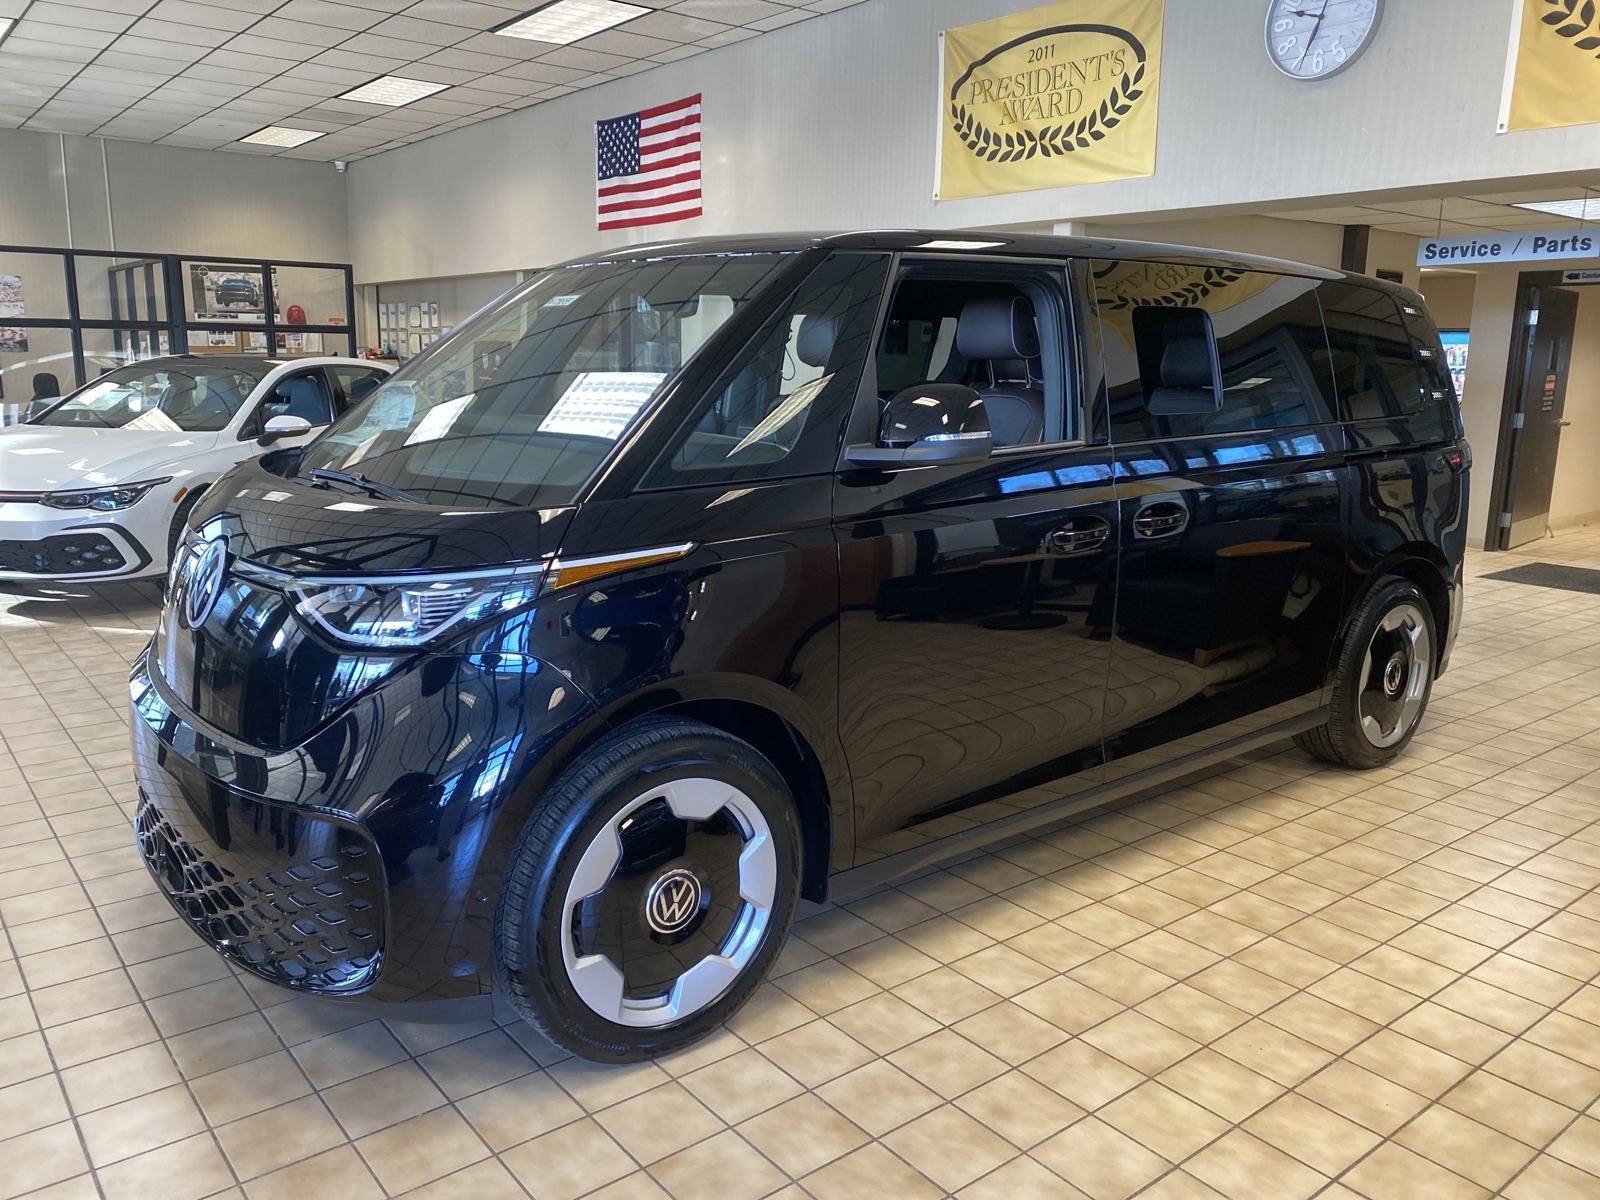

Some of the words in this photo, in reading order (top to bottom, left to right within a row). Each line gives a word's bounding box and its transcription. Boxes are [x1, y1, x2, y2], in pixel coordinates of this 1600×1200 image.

[1027, 44, 1056, 64] 2011
[1277, 36, 1297, 55] 8
[1312, 48, 1324, 73] 6
[967, 48, 1126, 105] PRESIDENT'S
[999, 87, 1083, 126] AWARD
[1424, 241, 1502, 260] Service
[1511, 237, 1523, 255] /
[1532, 235, 1592, 253] Parts
[653, 876, 696, 926] VW
